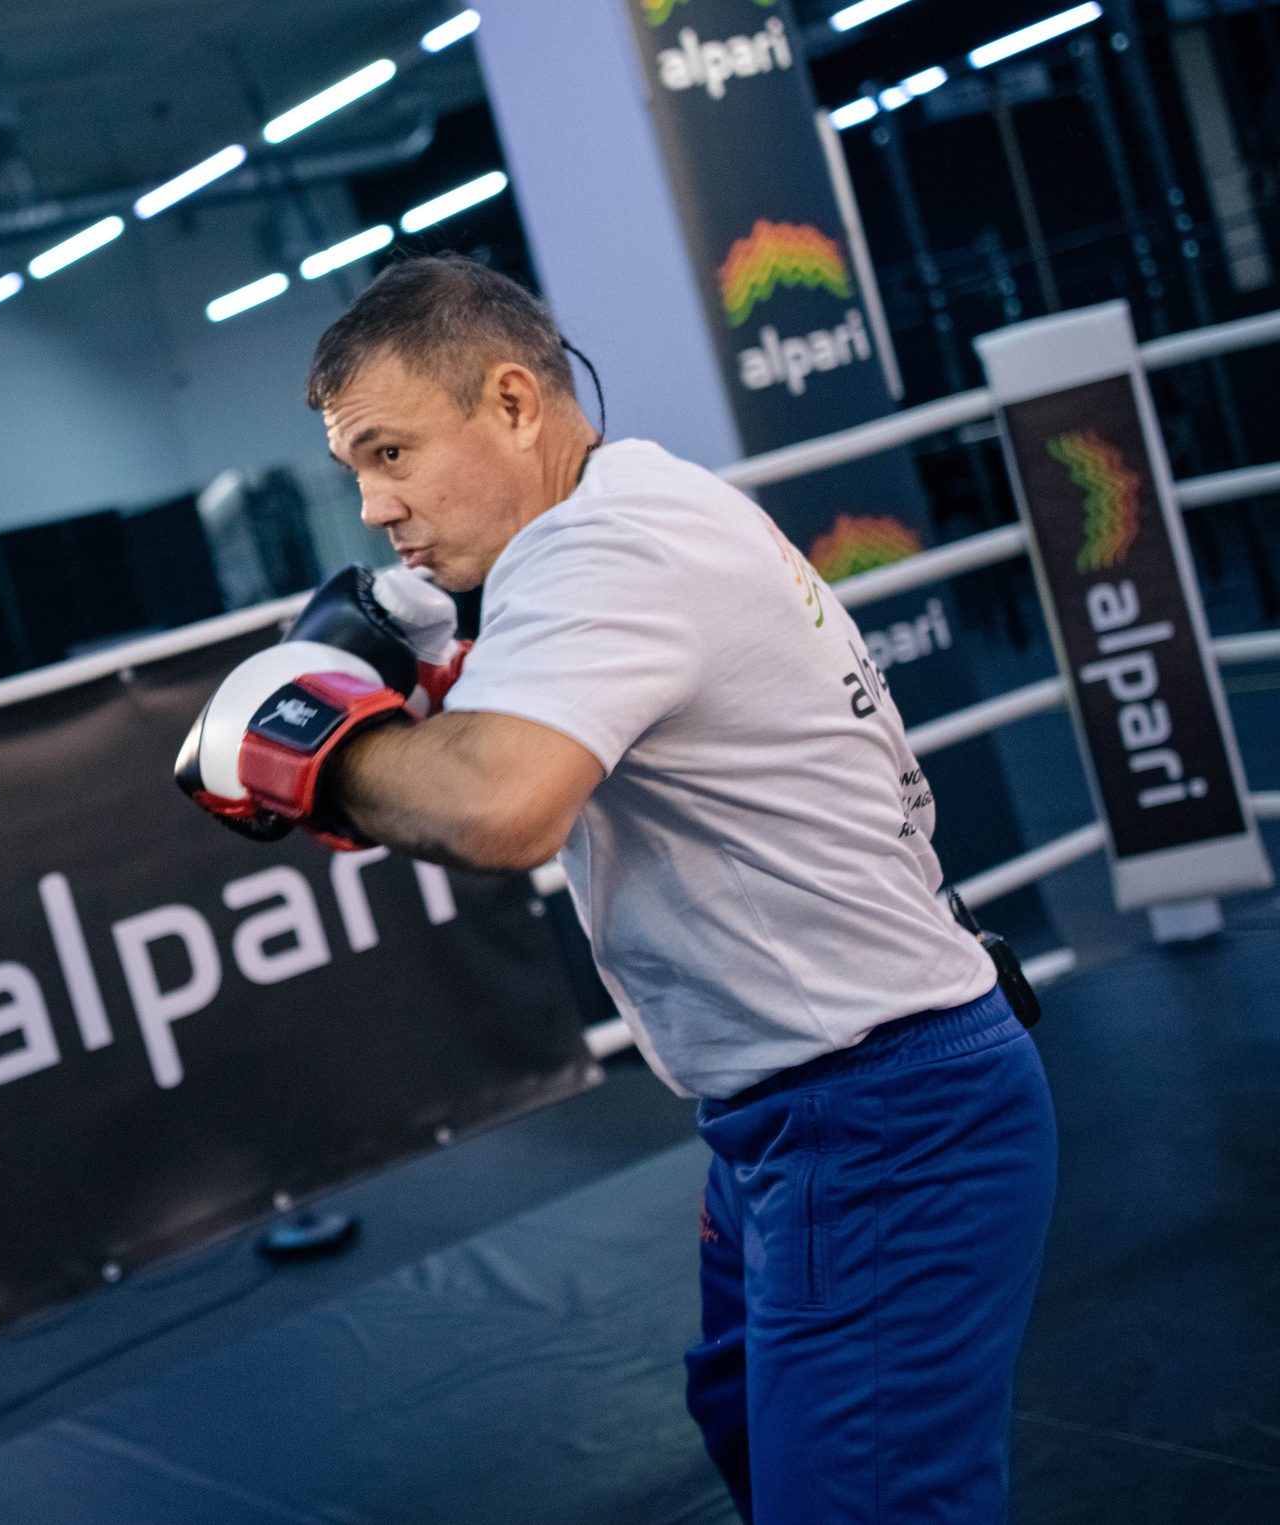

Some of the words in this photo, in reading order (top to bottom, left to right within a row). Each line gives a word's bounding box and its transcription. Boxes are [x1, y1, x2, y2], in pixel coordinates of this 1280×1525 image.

[658, 17, 792, 98] alpari
[738, 310, 872, 396] alpari
[861, 598, 951, 671] pari
[1080, 578, 1208, 809] alpari
